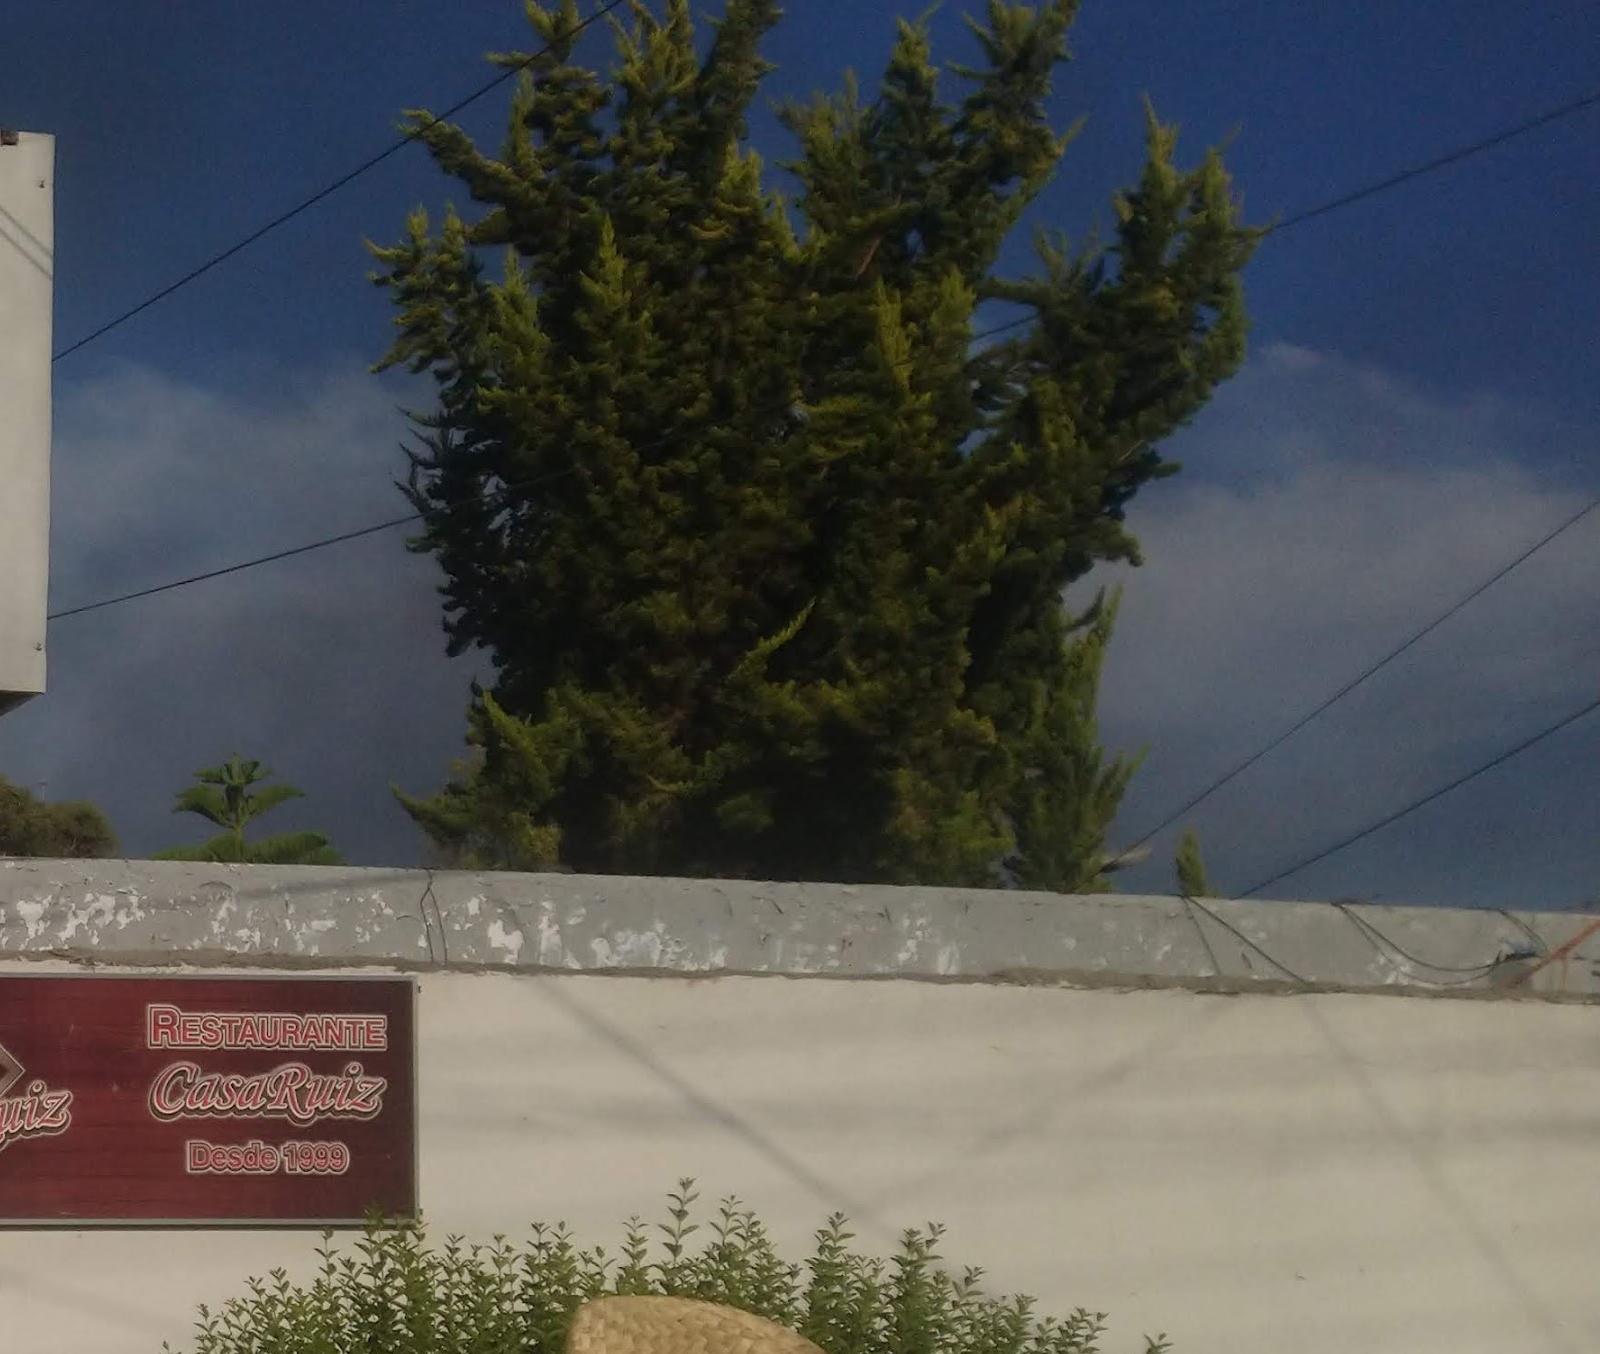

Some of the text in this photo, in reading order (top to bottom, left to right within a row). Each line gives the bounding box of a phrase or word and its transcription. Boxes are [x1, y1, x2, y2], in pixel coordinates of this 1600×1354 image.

[148, 1004, 387, 1052] RESTAURANTE
[186, 1140, 350, 1175] Desde 1999
